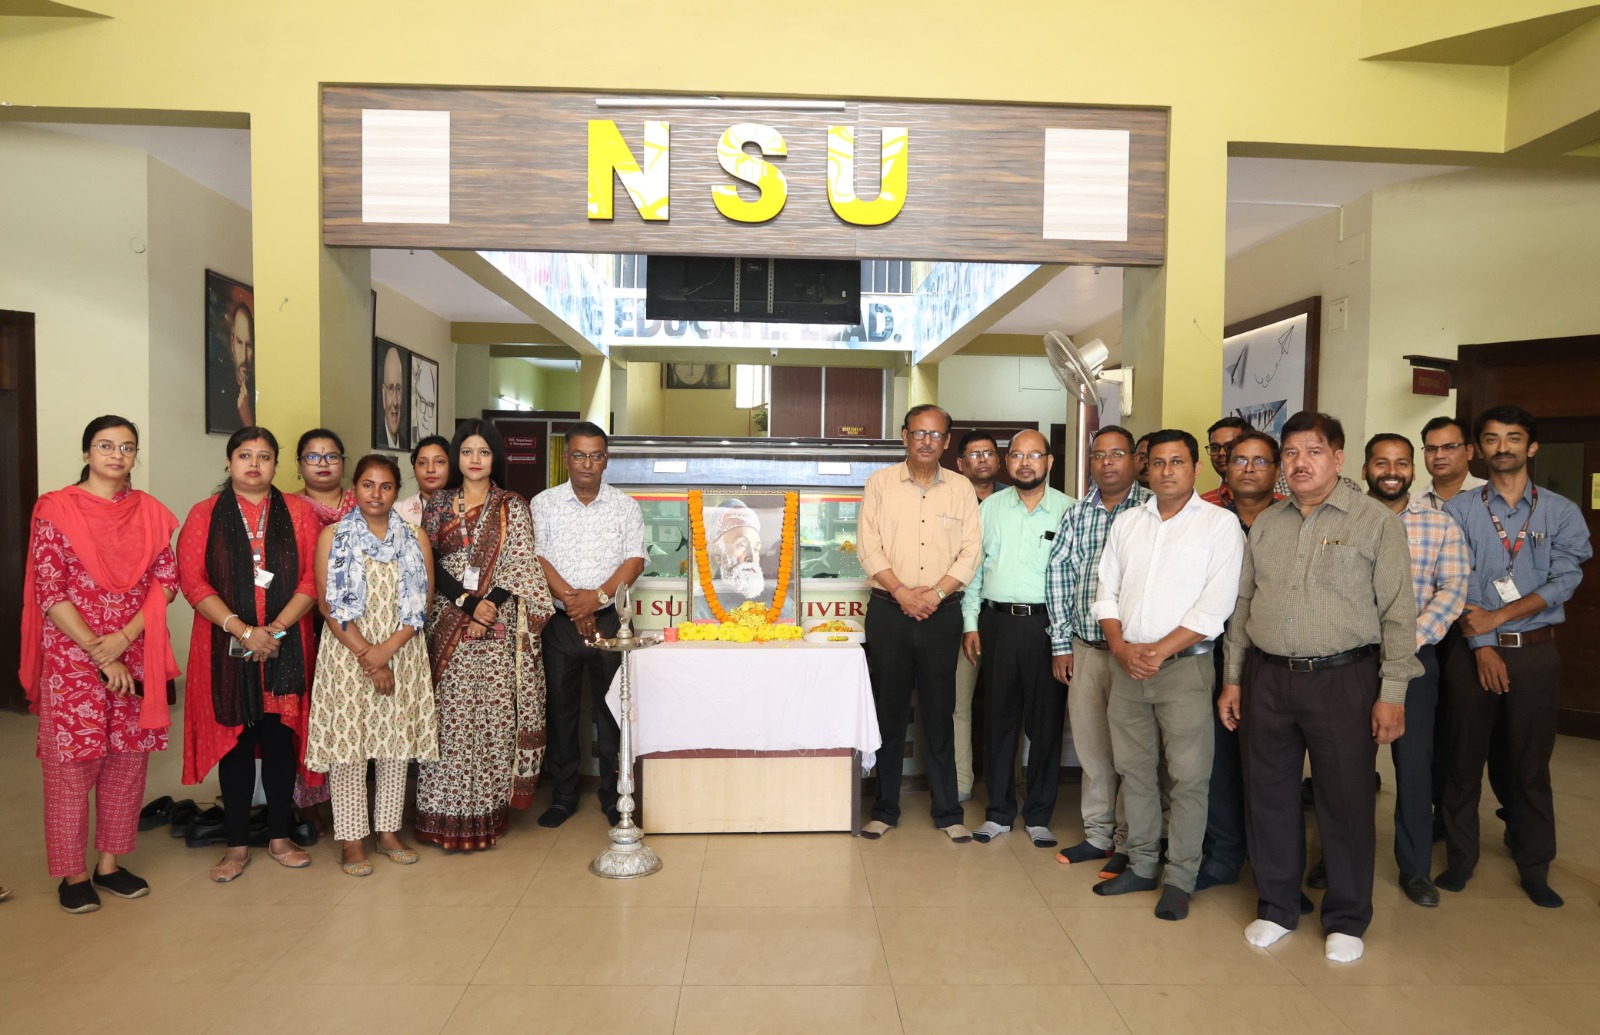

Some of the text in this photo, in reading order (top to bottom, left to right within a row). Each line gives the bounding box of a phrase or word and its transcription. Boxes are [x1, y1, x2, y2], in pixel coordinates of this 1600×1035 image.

[587, 119, 909, 227] NSU
[651, 600, 688, 617] SU
[801, 601, 865, 617] IVER
